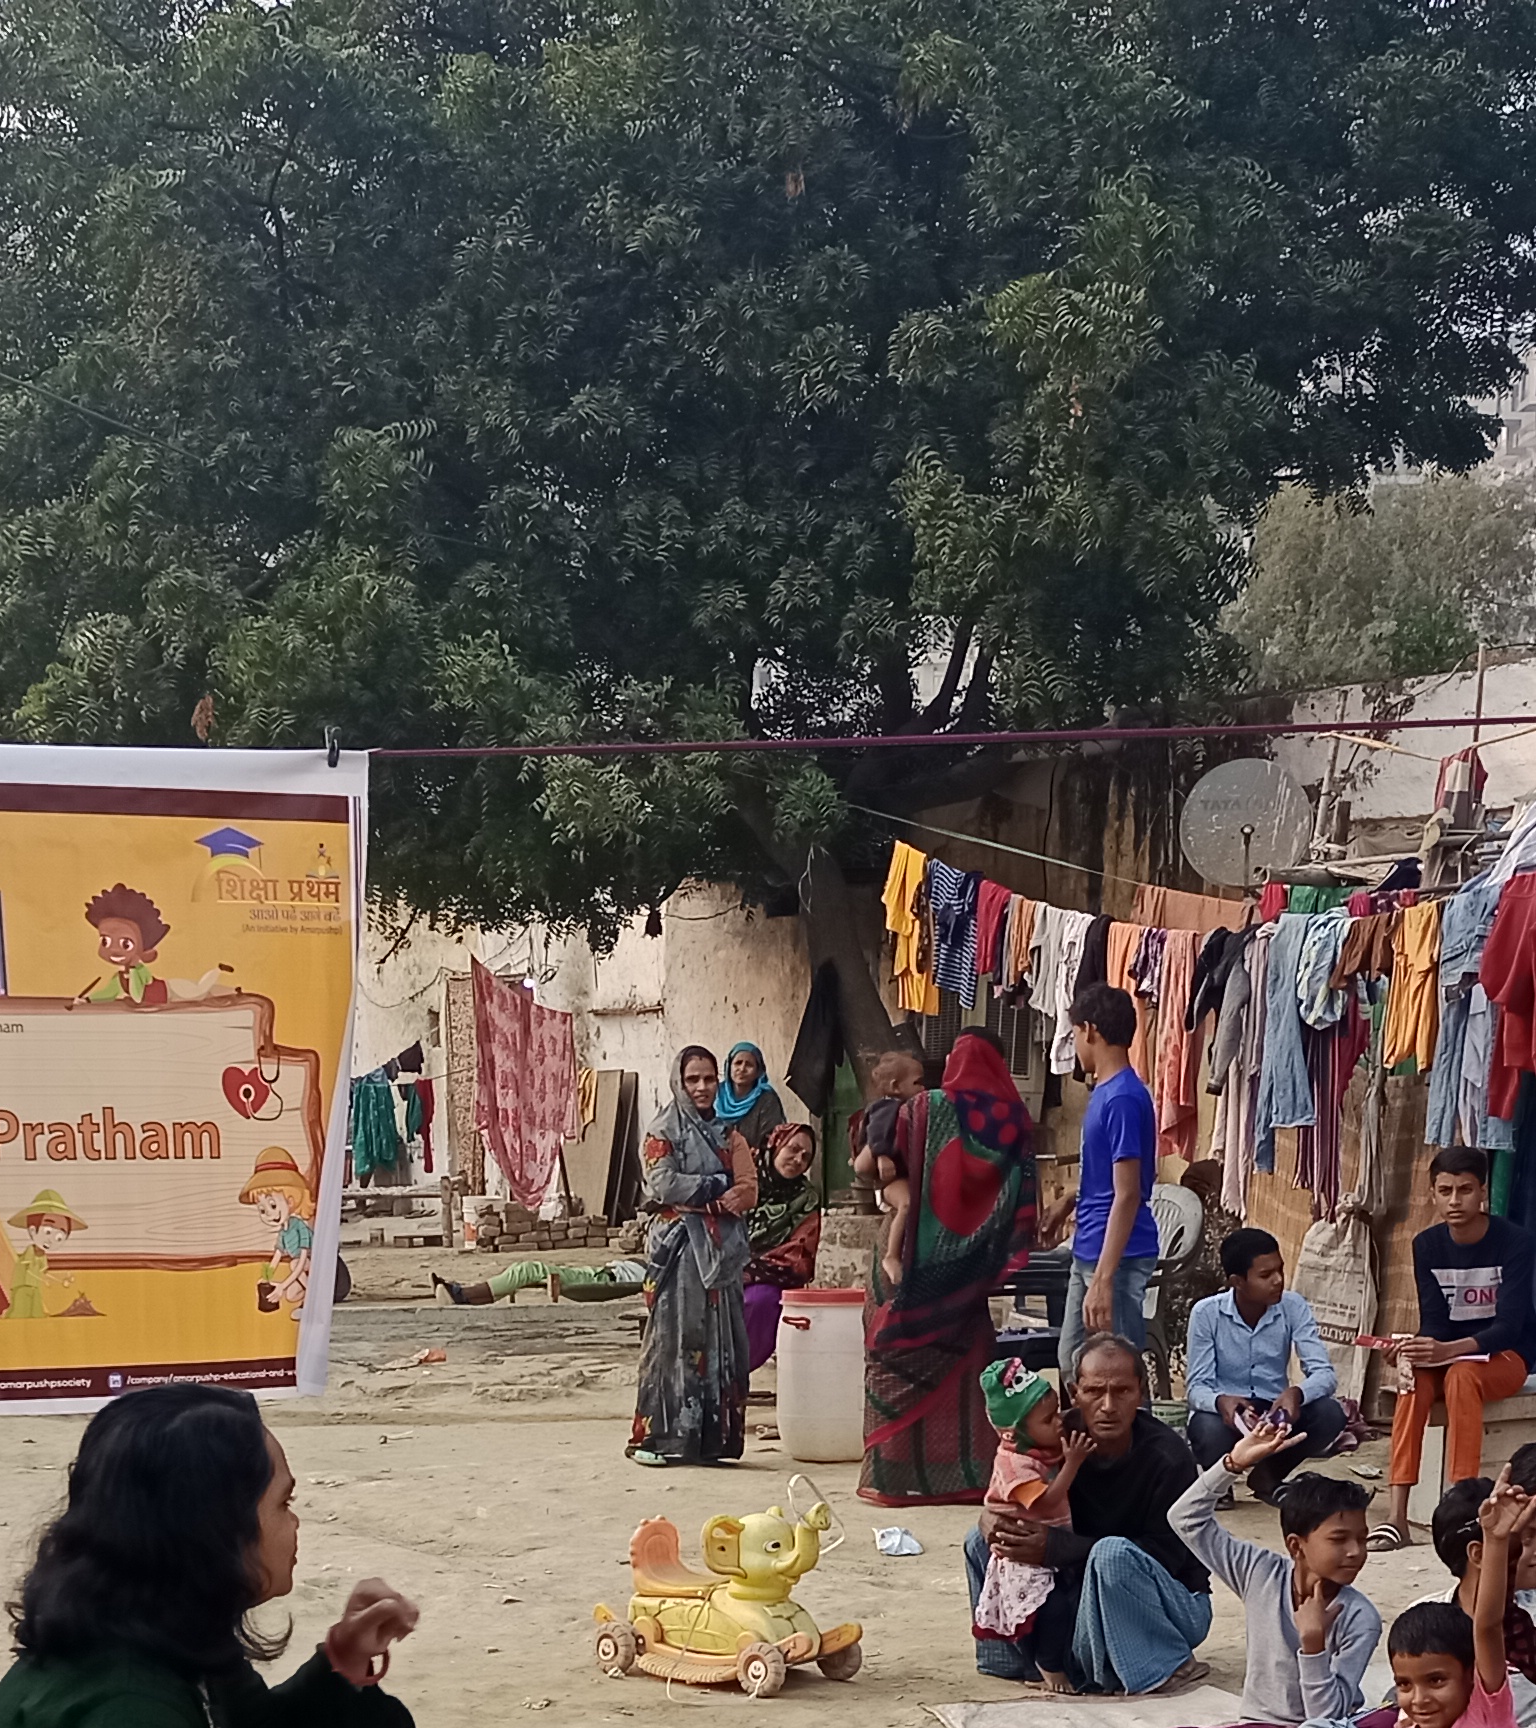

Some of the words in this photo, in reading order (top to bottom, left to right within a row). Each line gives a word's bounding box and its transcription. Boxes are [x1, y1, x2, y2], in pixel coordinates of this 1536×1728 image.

[215, 870, 278, 903] शिक्षा
[288, 879, 341, 903] प्रथम
[249, 905, 279, 921] आओ
